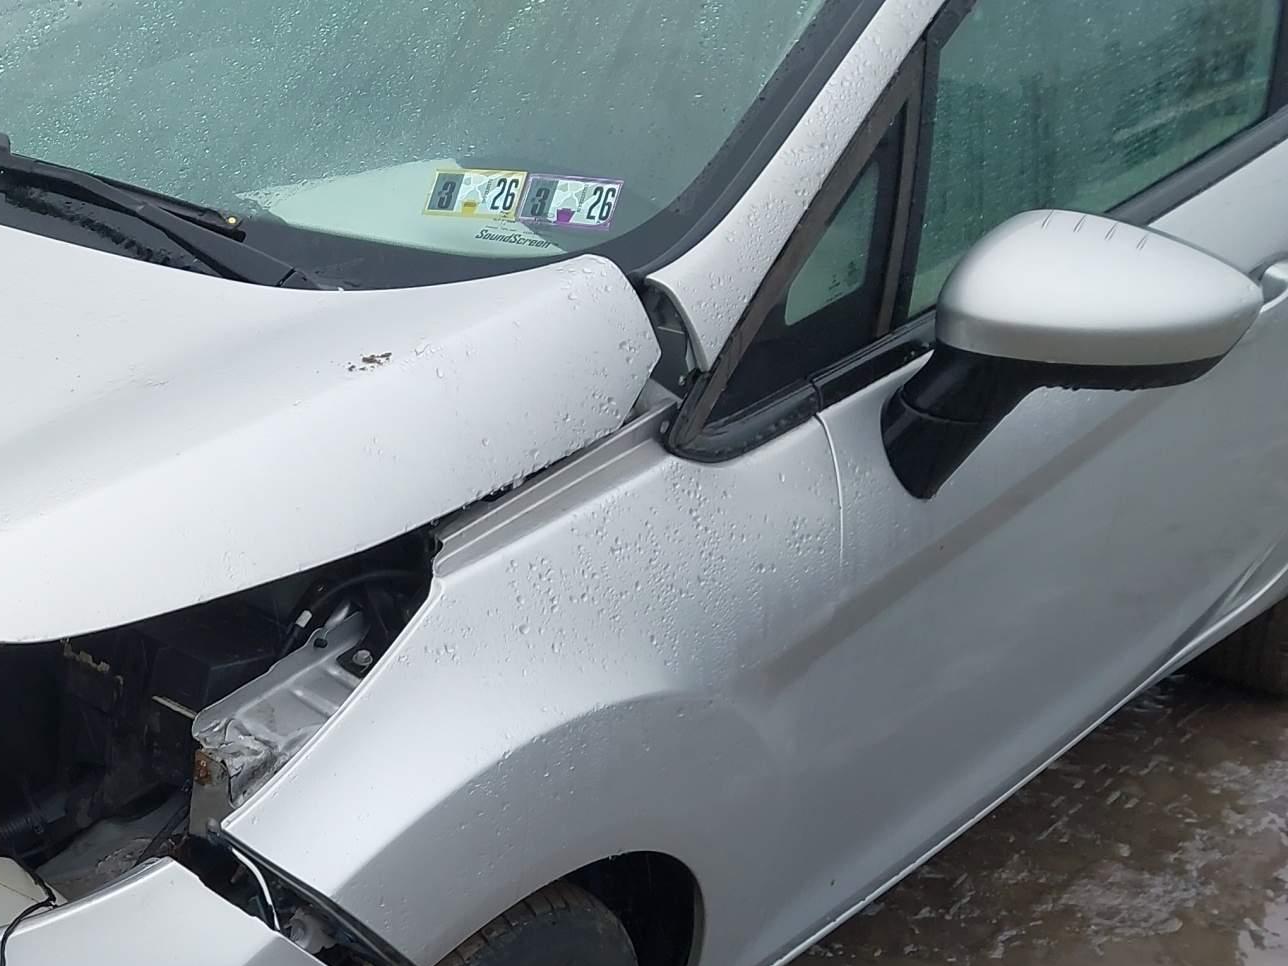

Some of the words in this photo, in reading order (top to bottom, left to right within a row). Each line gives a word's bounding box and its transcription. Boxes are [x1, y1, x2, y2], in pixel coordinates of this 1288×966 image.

[438, 181, 456, 208] 3
[490, 178, 519, 210] 26
[531, 188, 550, 217] 3
[587, 186, 616, 220] 26
